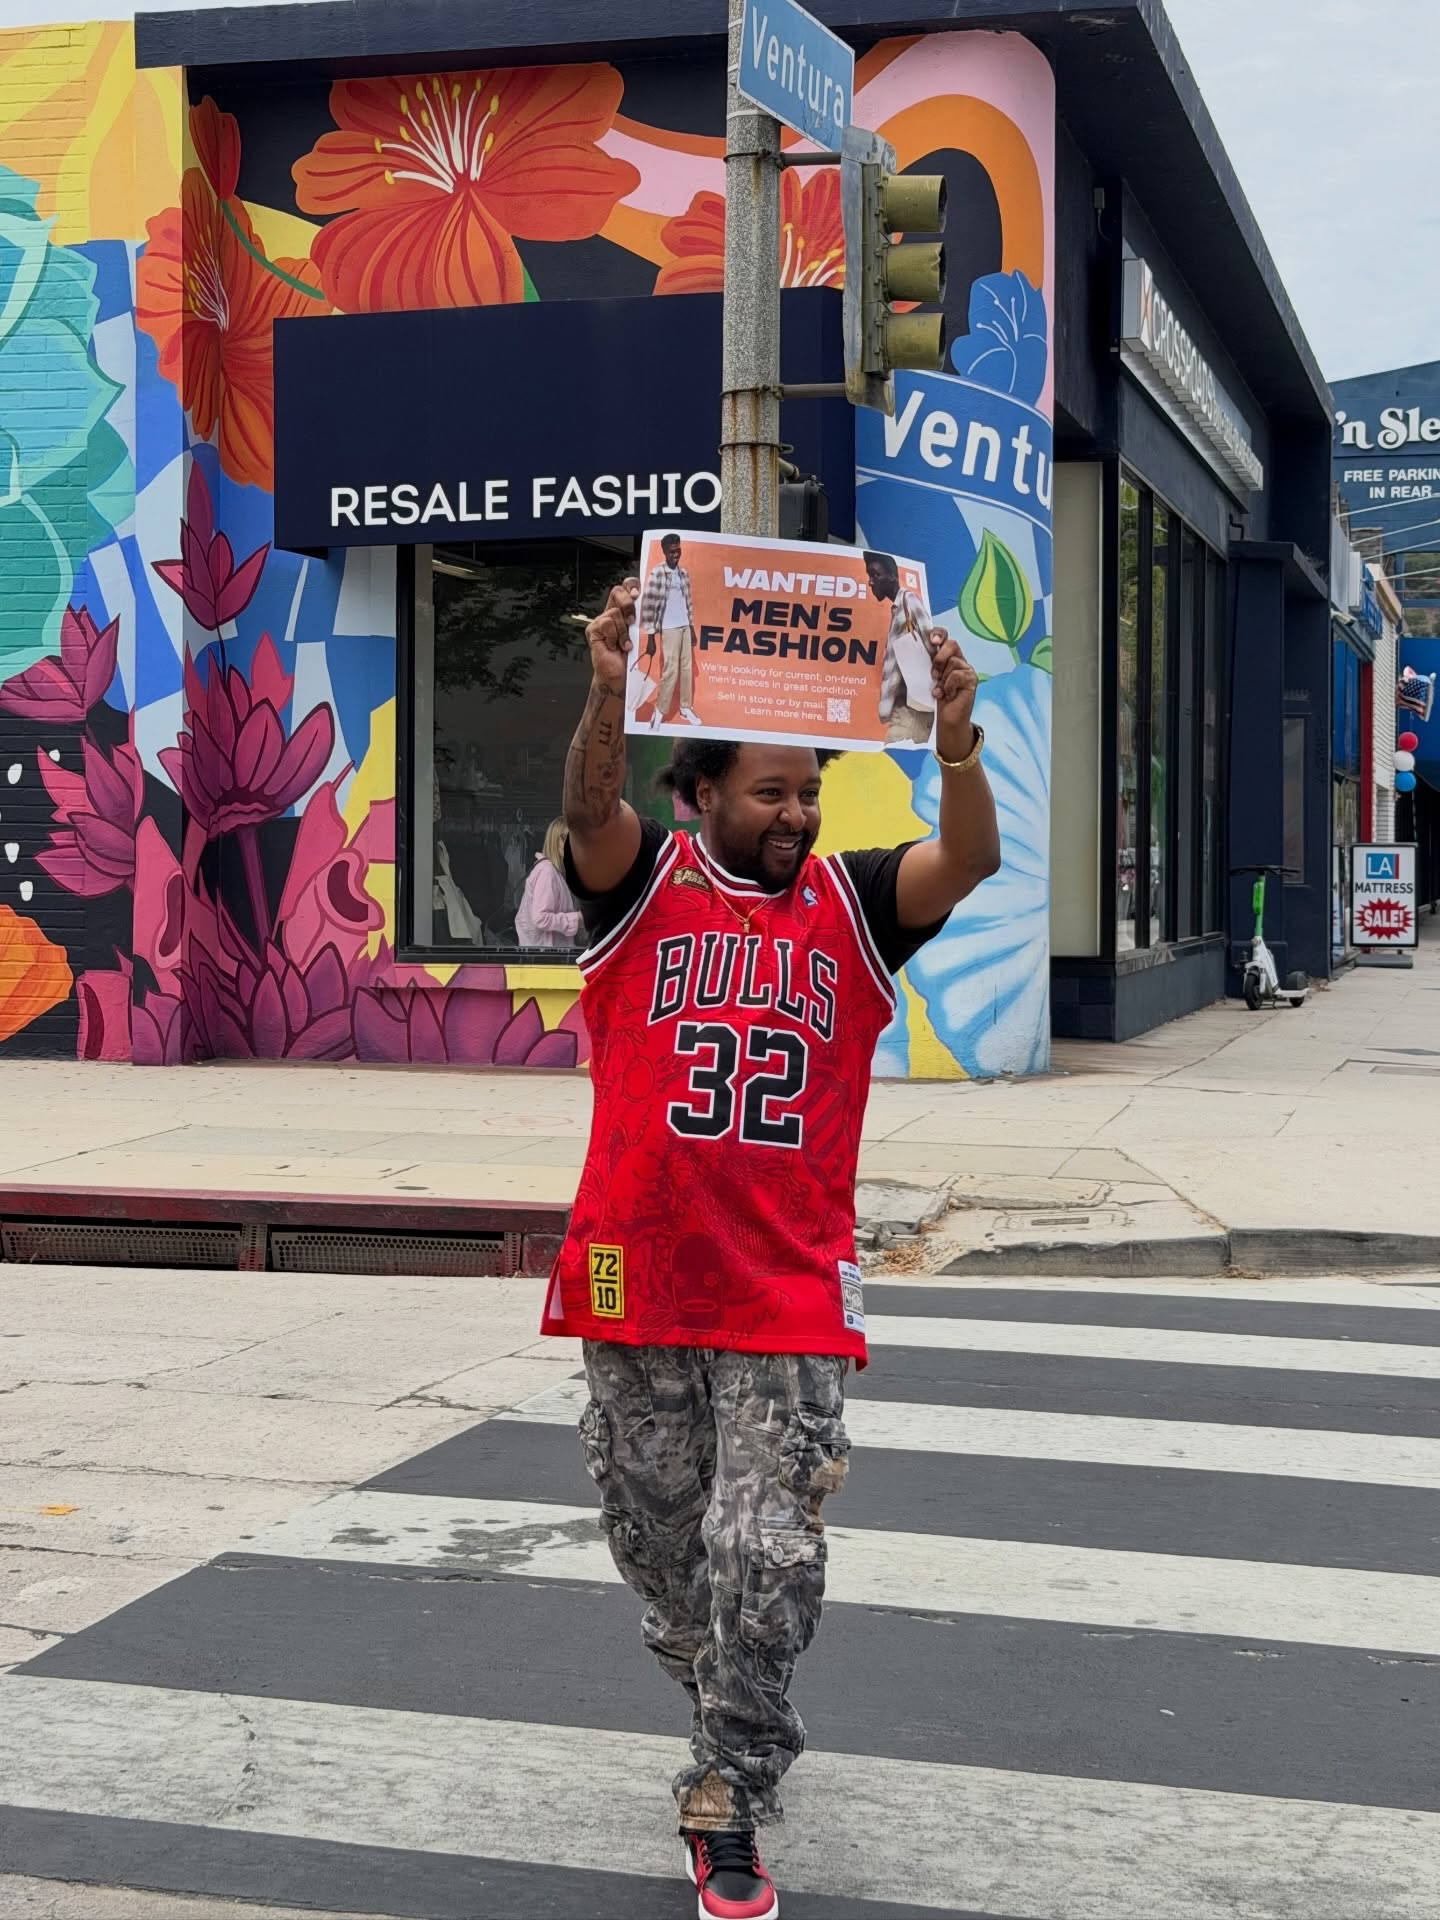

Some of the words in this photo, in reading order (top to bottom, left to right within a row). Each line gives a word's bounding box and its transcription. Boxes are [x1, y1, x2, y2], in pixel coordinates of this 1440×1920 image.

[751, 4, 845, 129] Ventura
[1377, 406, 1440, 450] Sle
[1343, 468, 1384, 483] FREE
[330, 479, 509, 527] RESALE
[532, 471, 722, 518] FASHIO
[1369, 486, 1385, 499] IN
[1390, 484, 1432, 498] REAR
[723, 566, 867, 600] WANTED:
[731, 598, 853, 632] MEN'S
[700, 625, 878, 666] FASHION
[701, 661, 729, 674] We're
[731, 664, 767, 678] looking
[769, 667, 783, 678] for
[785, 671, 823, 682] current,
[825, 673, 867, 686] on-trend
[708, 674, 736, 685] men's
[738, 677, 769, 689] pieces
[772, 679, 781, 689] in
[783, 681, 808, 693] great
[811, 684, 858, 697] condition.
[717, 691, 736, 701] Sell
[738, 692, 747, 702] in
[749, 694, 773, 705] store
[776, 698, 787, 706] or
[789, 698, 801, 710] by
[744, 707, 772, 717] Learn
[774, 710, 799, 719] more
[801, 711, 825, 721] here.
[1367, 856, 1393, 876] LA
[1354, 882, 1414, 894] MATTRESS
[1363, 908, 1405, 928] SALE!
[647, 931, 838, 1043] BULLS
[667, 1023, 809, 1148] 32
[593, 1251, 618, 1277] 72
[597, 1285, 618, 1312] 10
